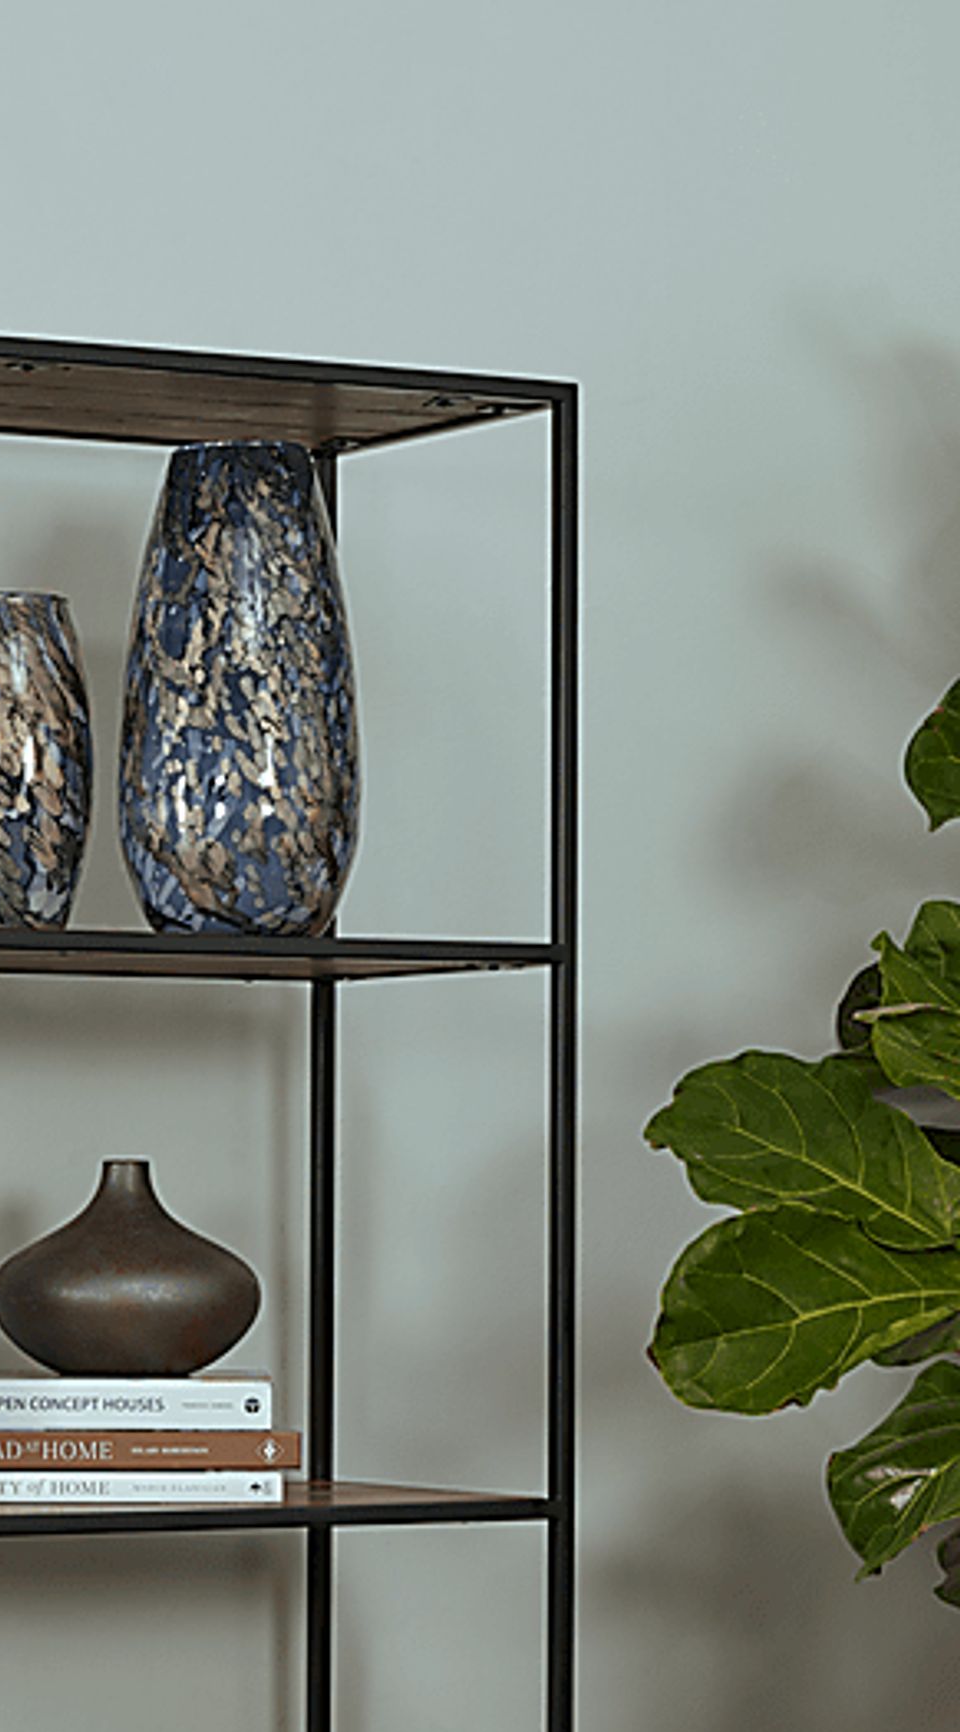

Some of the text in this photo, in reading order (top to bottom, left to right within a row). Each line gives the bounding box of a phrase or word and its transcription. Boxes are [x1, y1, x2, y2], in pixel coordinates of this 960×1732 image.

[29, 1396, 97, 1413] CONCEPT
[102, 1397, 165, 1413] HOUSES
[43, 1440, 113, 1461] HOME
[50, 1480, 111, 1496] HOME
